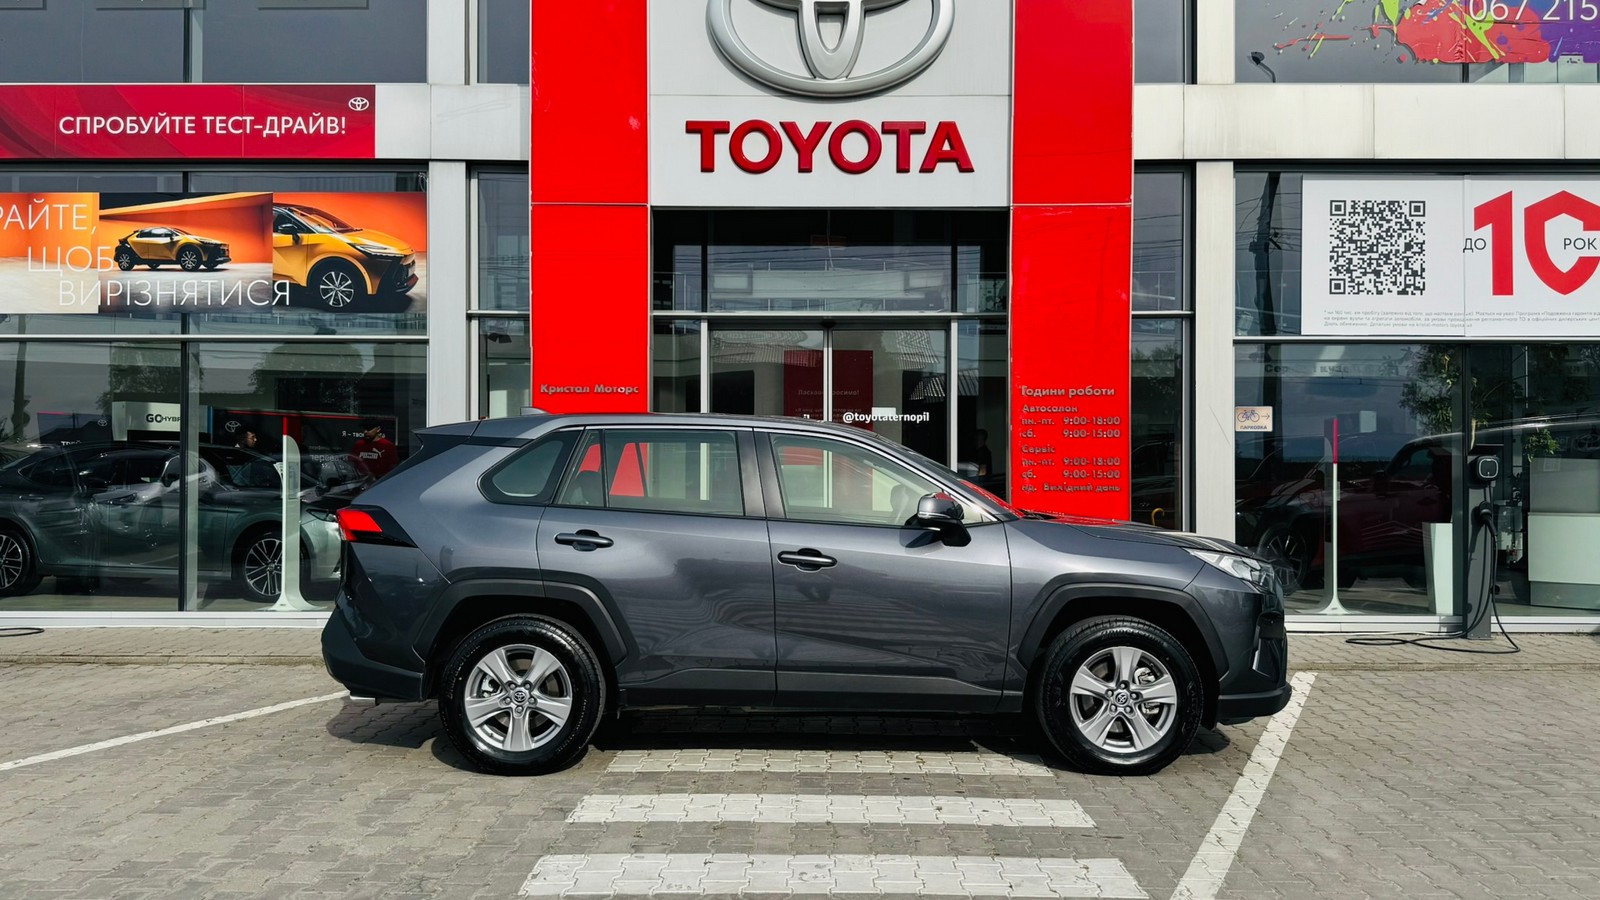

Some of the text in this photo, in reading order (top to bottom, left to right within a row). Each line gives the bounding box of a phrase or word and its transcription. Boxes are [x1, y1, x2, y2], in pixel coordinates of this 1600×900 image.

[1469, 0, 1598, 21] 067 215
[58, 112, 347, 137] СПРОБУЙТЕ ТЕСТ-ДРАЙВ!
[685, 119, 975, 174] TOYOTA
[1463, 237, 1487, 253] ДО
[28, 246, 114, 277] ЩОБ
[58, 280, 291, 306] ВИРІЗНЯТИСЯ
[540, 384, 639, 395] Кристал Моторс
[1021, 385, 1115, 398] Години роботи
[1021, 404, 1078, 413] Автосалон
[842, 411, 930, 423] @toyotaternopil
[1021, 444, 1055, 455] Сервіс
